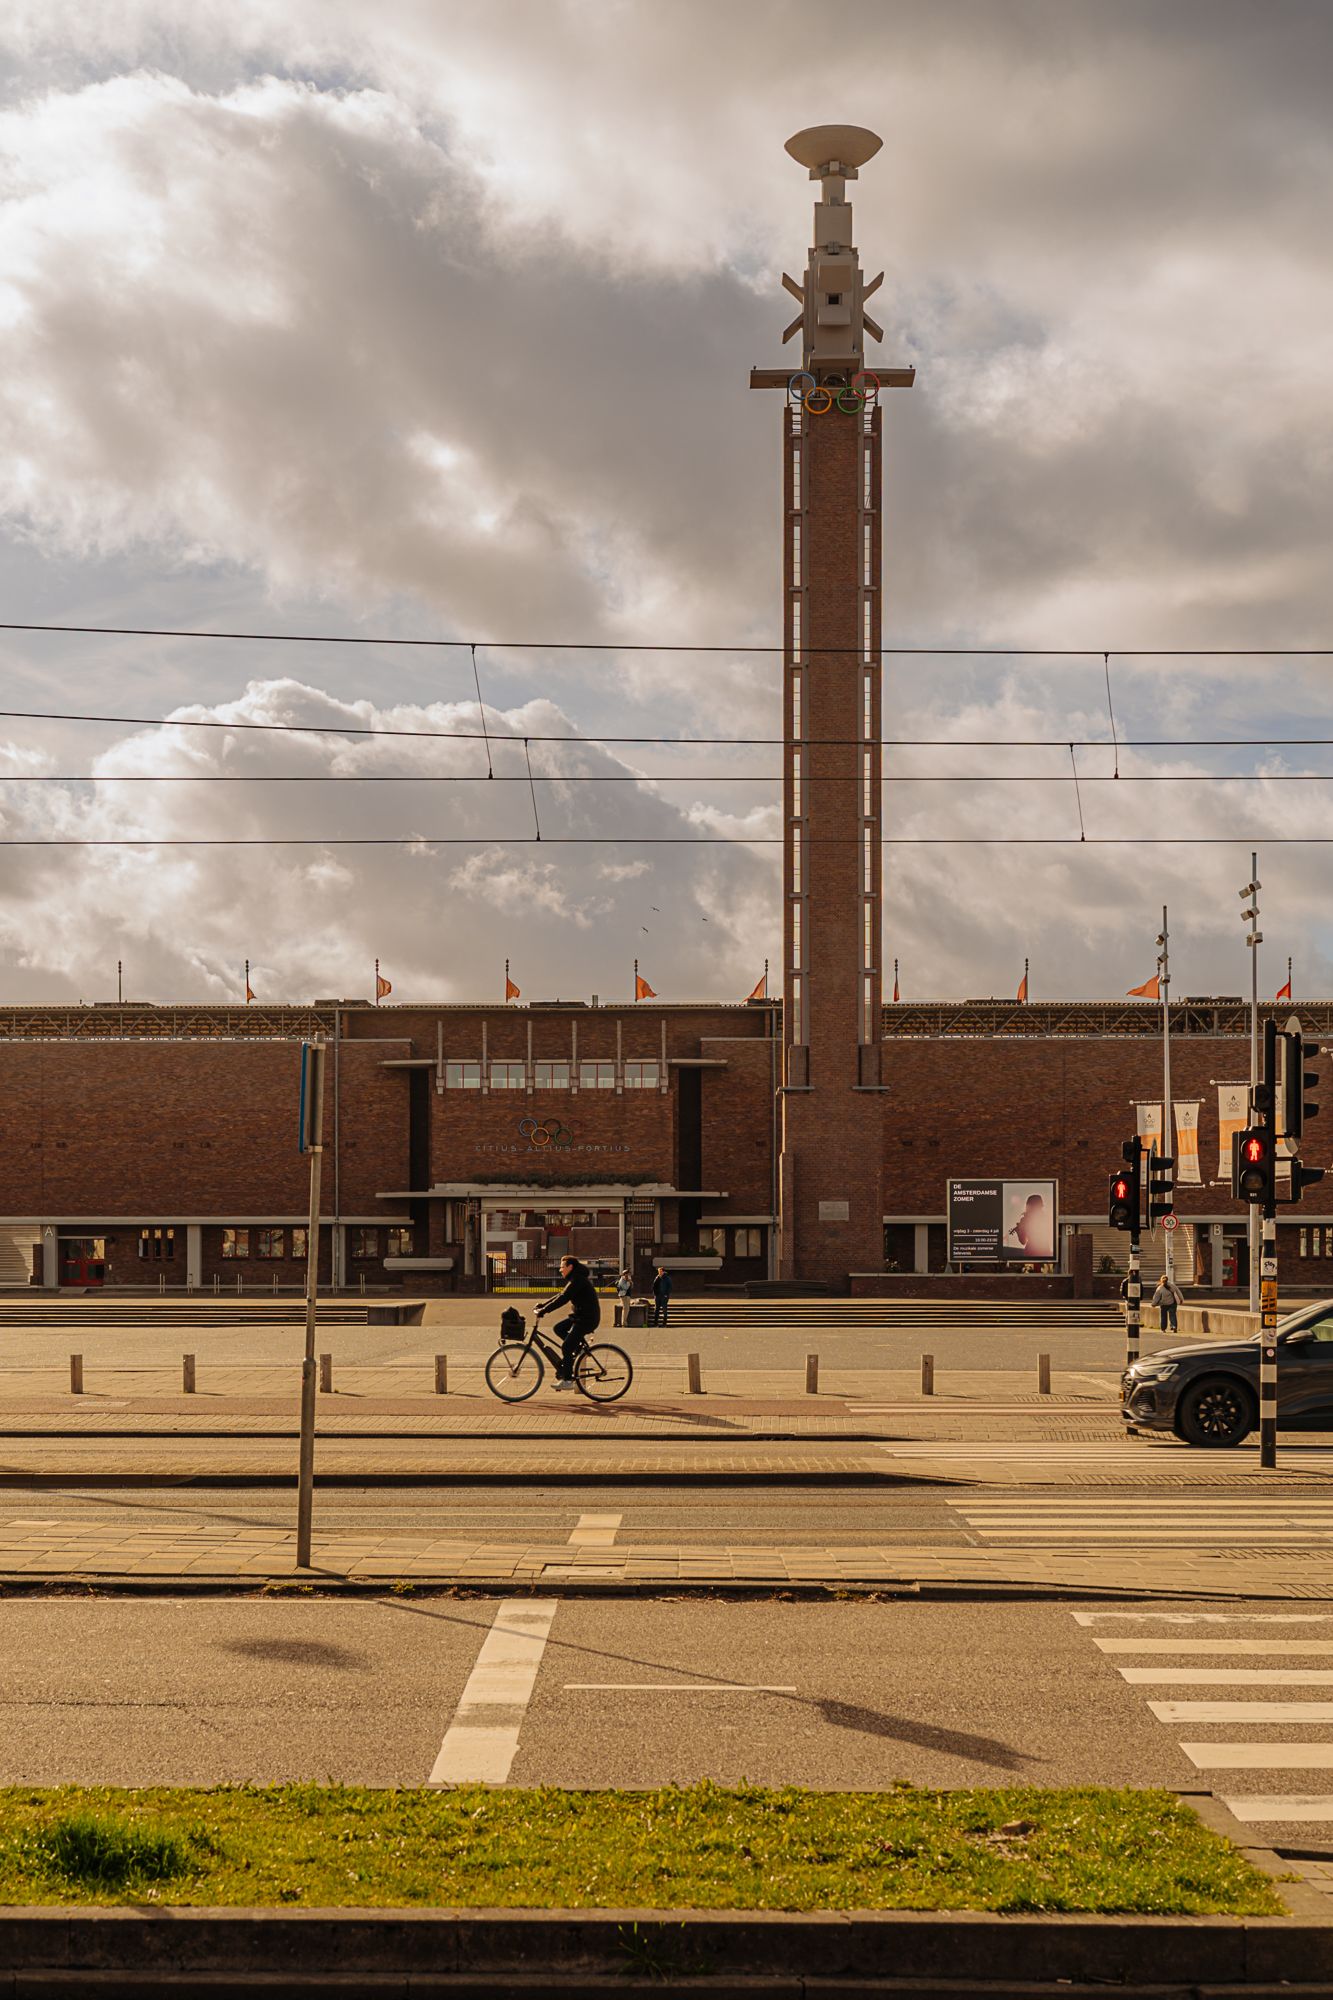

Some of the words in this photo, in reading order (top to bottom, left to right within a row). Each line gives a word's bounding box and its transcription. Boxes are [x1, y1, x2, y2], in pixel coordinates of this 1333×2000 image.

[45, 1226, 53, 1236] A
[1066, 1225, 1073, 1235] B
[1214, 1225, 1221, 1235] B
